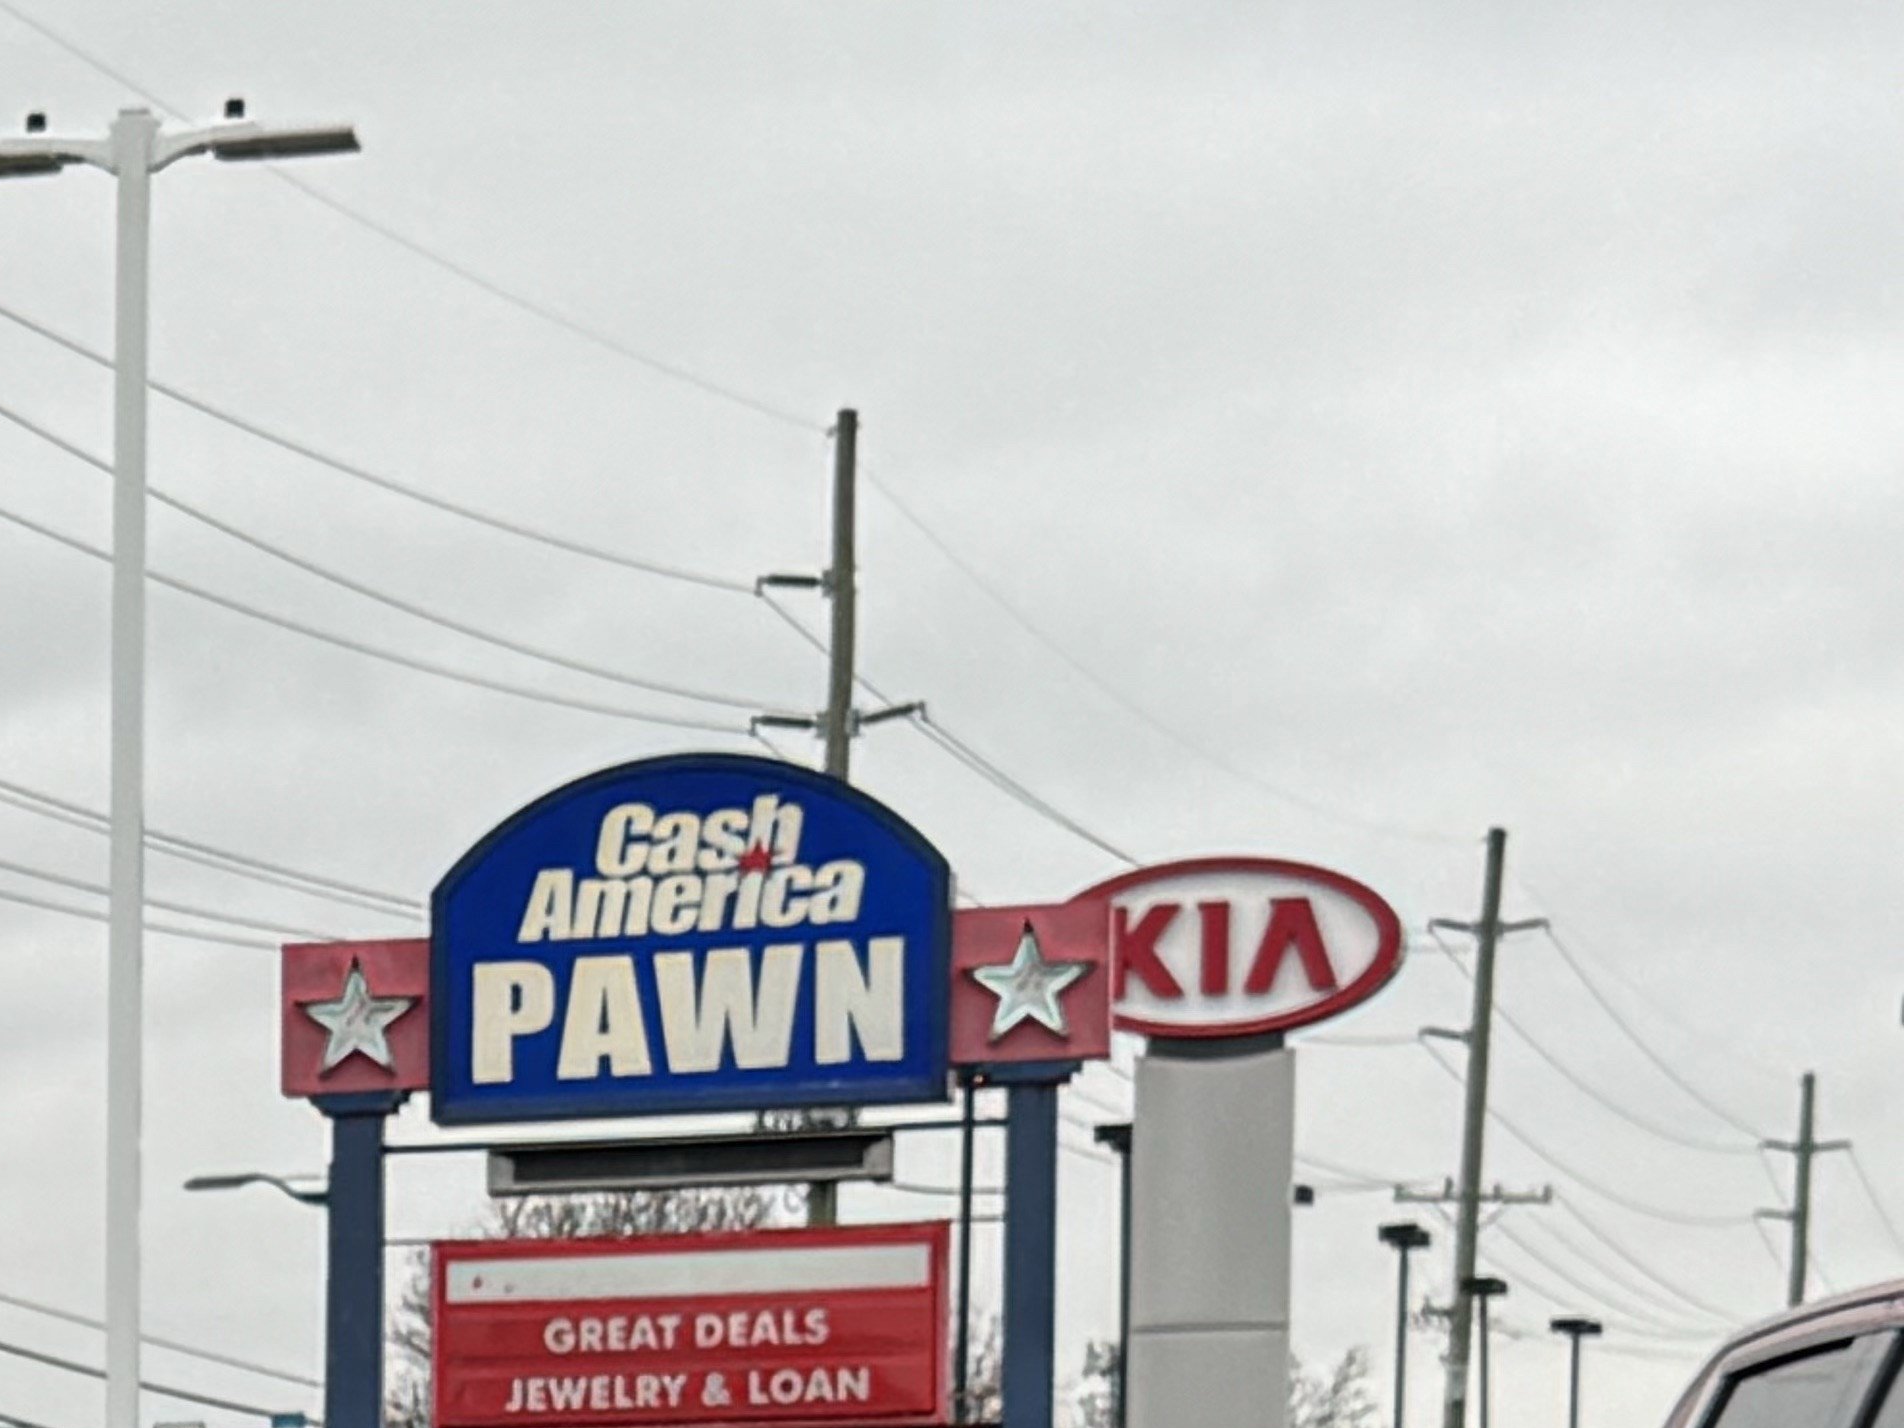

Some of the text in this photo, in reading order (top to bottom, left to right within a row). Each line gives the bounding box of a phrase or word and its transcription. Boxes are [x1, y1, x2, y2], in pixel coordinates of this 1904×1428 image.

[595, 794, 804, 878] Cash
[516, 859, 866, 943] America
[1113, 897, 1339, 1001] KIA
[471, 935, 906, 1084] PAWN
[543, 1308, 831, 1354] GREAT DEALS
[505, 1366, 872, 1412] JEWELRY & LOAN
